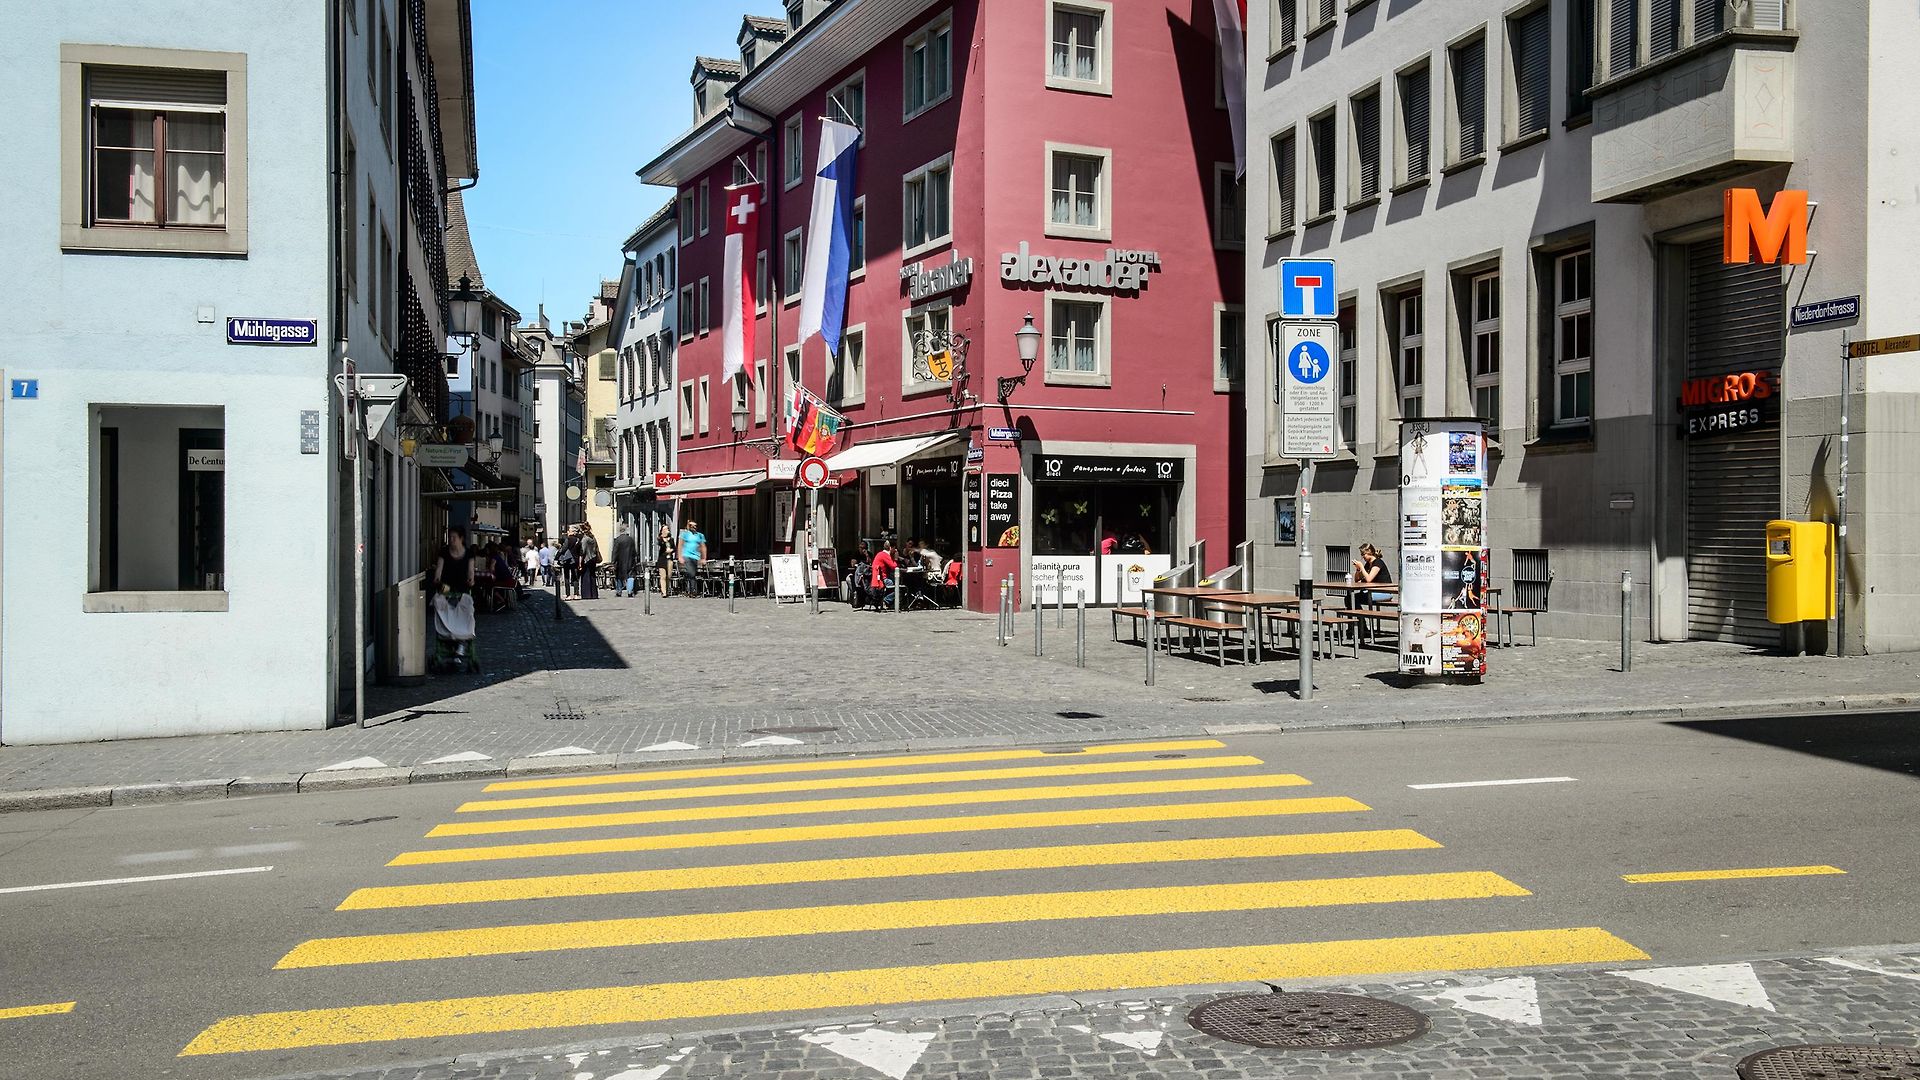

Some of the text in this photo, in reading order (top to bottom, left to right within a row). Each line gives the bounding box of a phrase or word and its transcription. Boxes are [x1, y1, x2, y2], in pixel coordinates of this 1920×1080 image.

[1724, 188, 1808, 264] M
[1114, 249, 1162, 264] HOTEL
[1000, 241, 1149, 290] alexander
[909, 249, 973, 301] alexander
[1795, 302, 1855, 322] Niederdorfstrasse
[234, 320, 309, 341] Mühlegasse
[1297, 328, 1321, 338] ZONE
[1856, 339, 1911, 356] HOTEL Alexander
[21, 382, 28, 396] 7
[1681, 371, 1772, 406] MIGROS
[1689, 408, 1759, 434] EXPRESS
[189, 456, 199, 465] De
[990, 479, 1010, 488] dieci
[968, 490, 980, 499] Pasta
[990, 489, 1013, 499] Pizza
[990, 501, 1008, 510] take
[990, 513, 1012, 522] away
[1063, 564, 1080, 572] pura
[1403, 655, 1433, 665] IMANY
